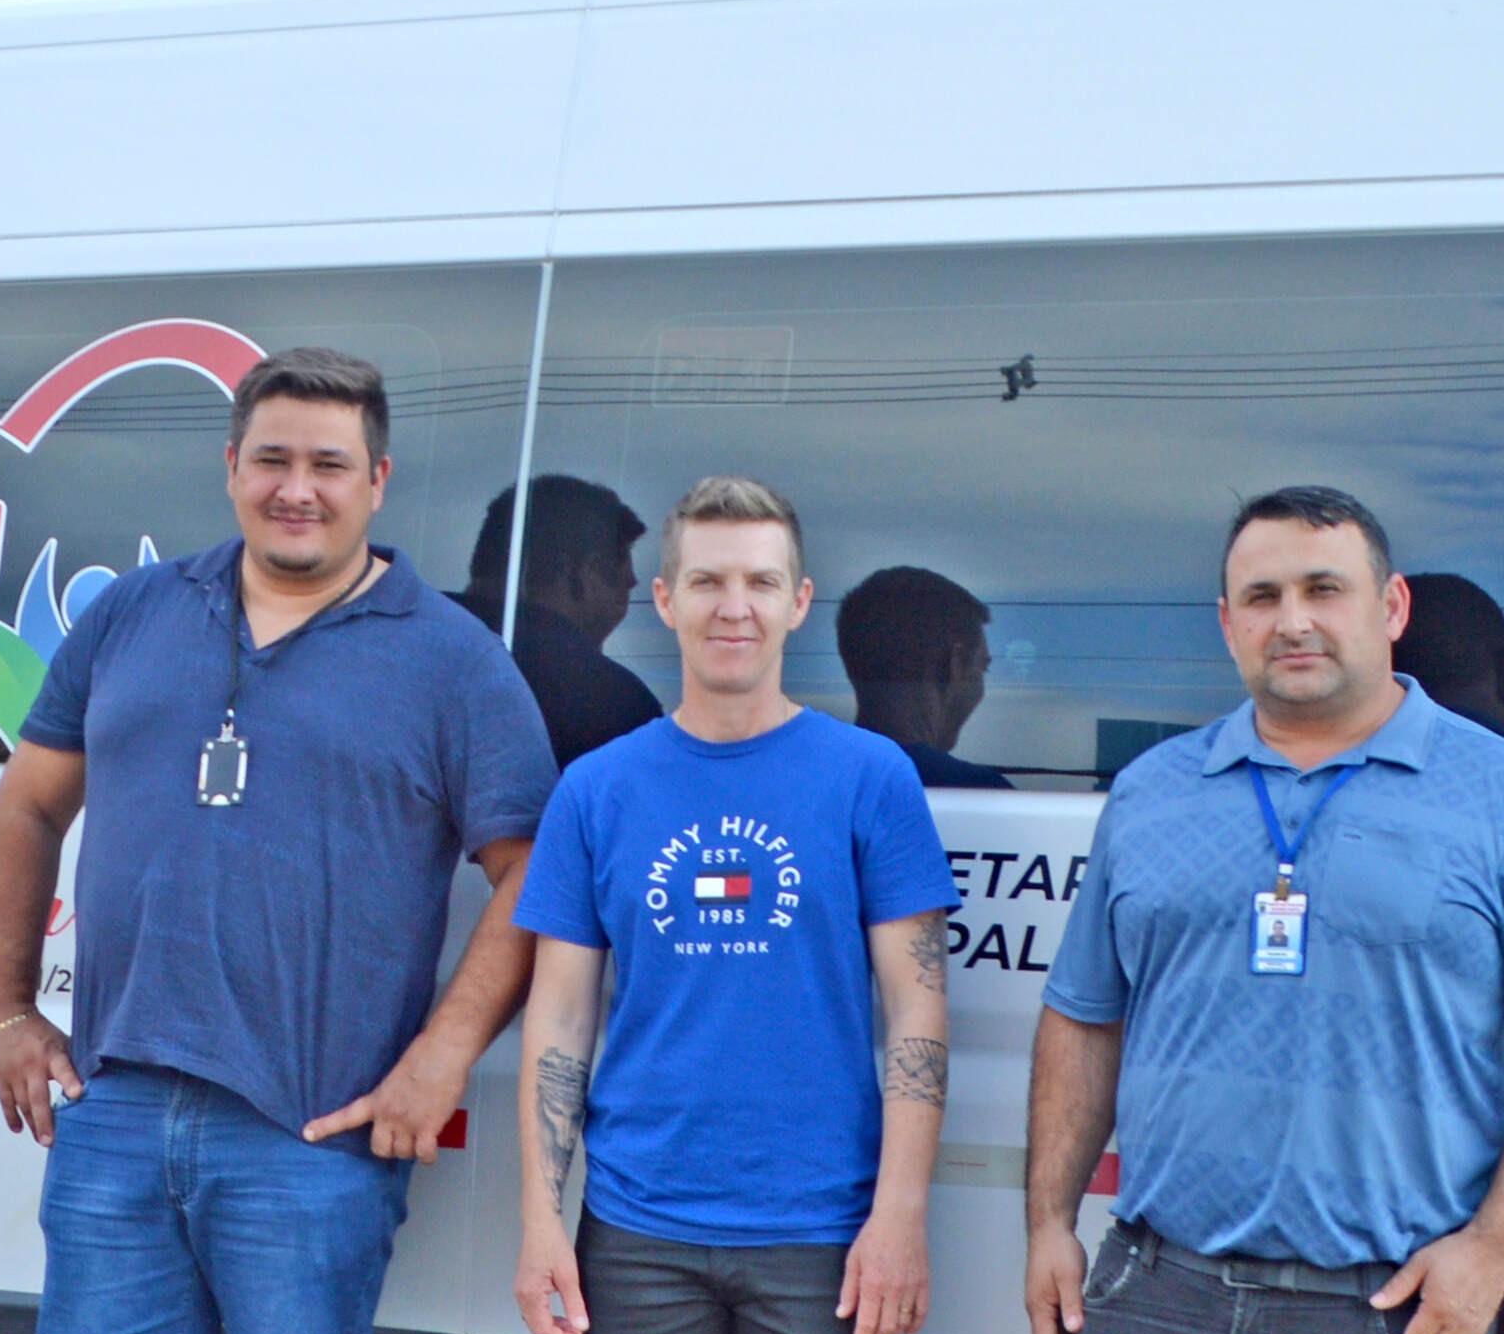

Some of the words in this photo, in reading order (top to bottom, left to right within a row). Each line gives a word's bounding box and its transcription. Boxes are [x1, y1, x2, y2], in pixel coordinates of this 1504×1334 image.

[701, 848, 747, 864] EST.
[645, 823, 702, 935] TOMMY
[720, 815, 802, 929] HILFIGER
[698, 908, 746, 925] 1985
[674, 942, 712, 955] NEW
[721, 940, 769, 955] YORK
